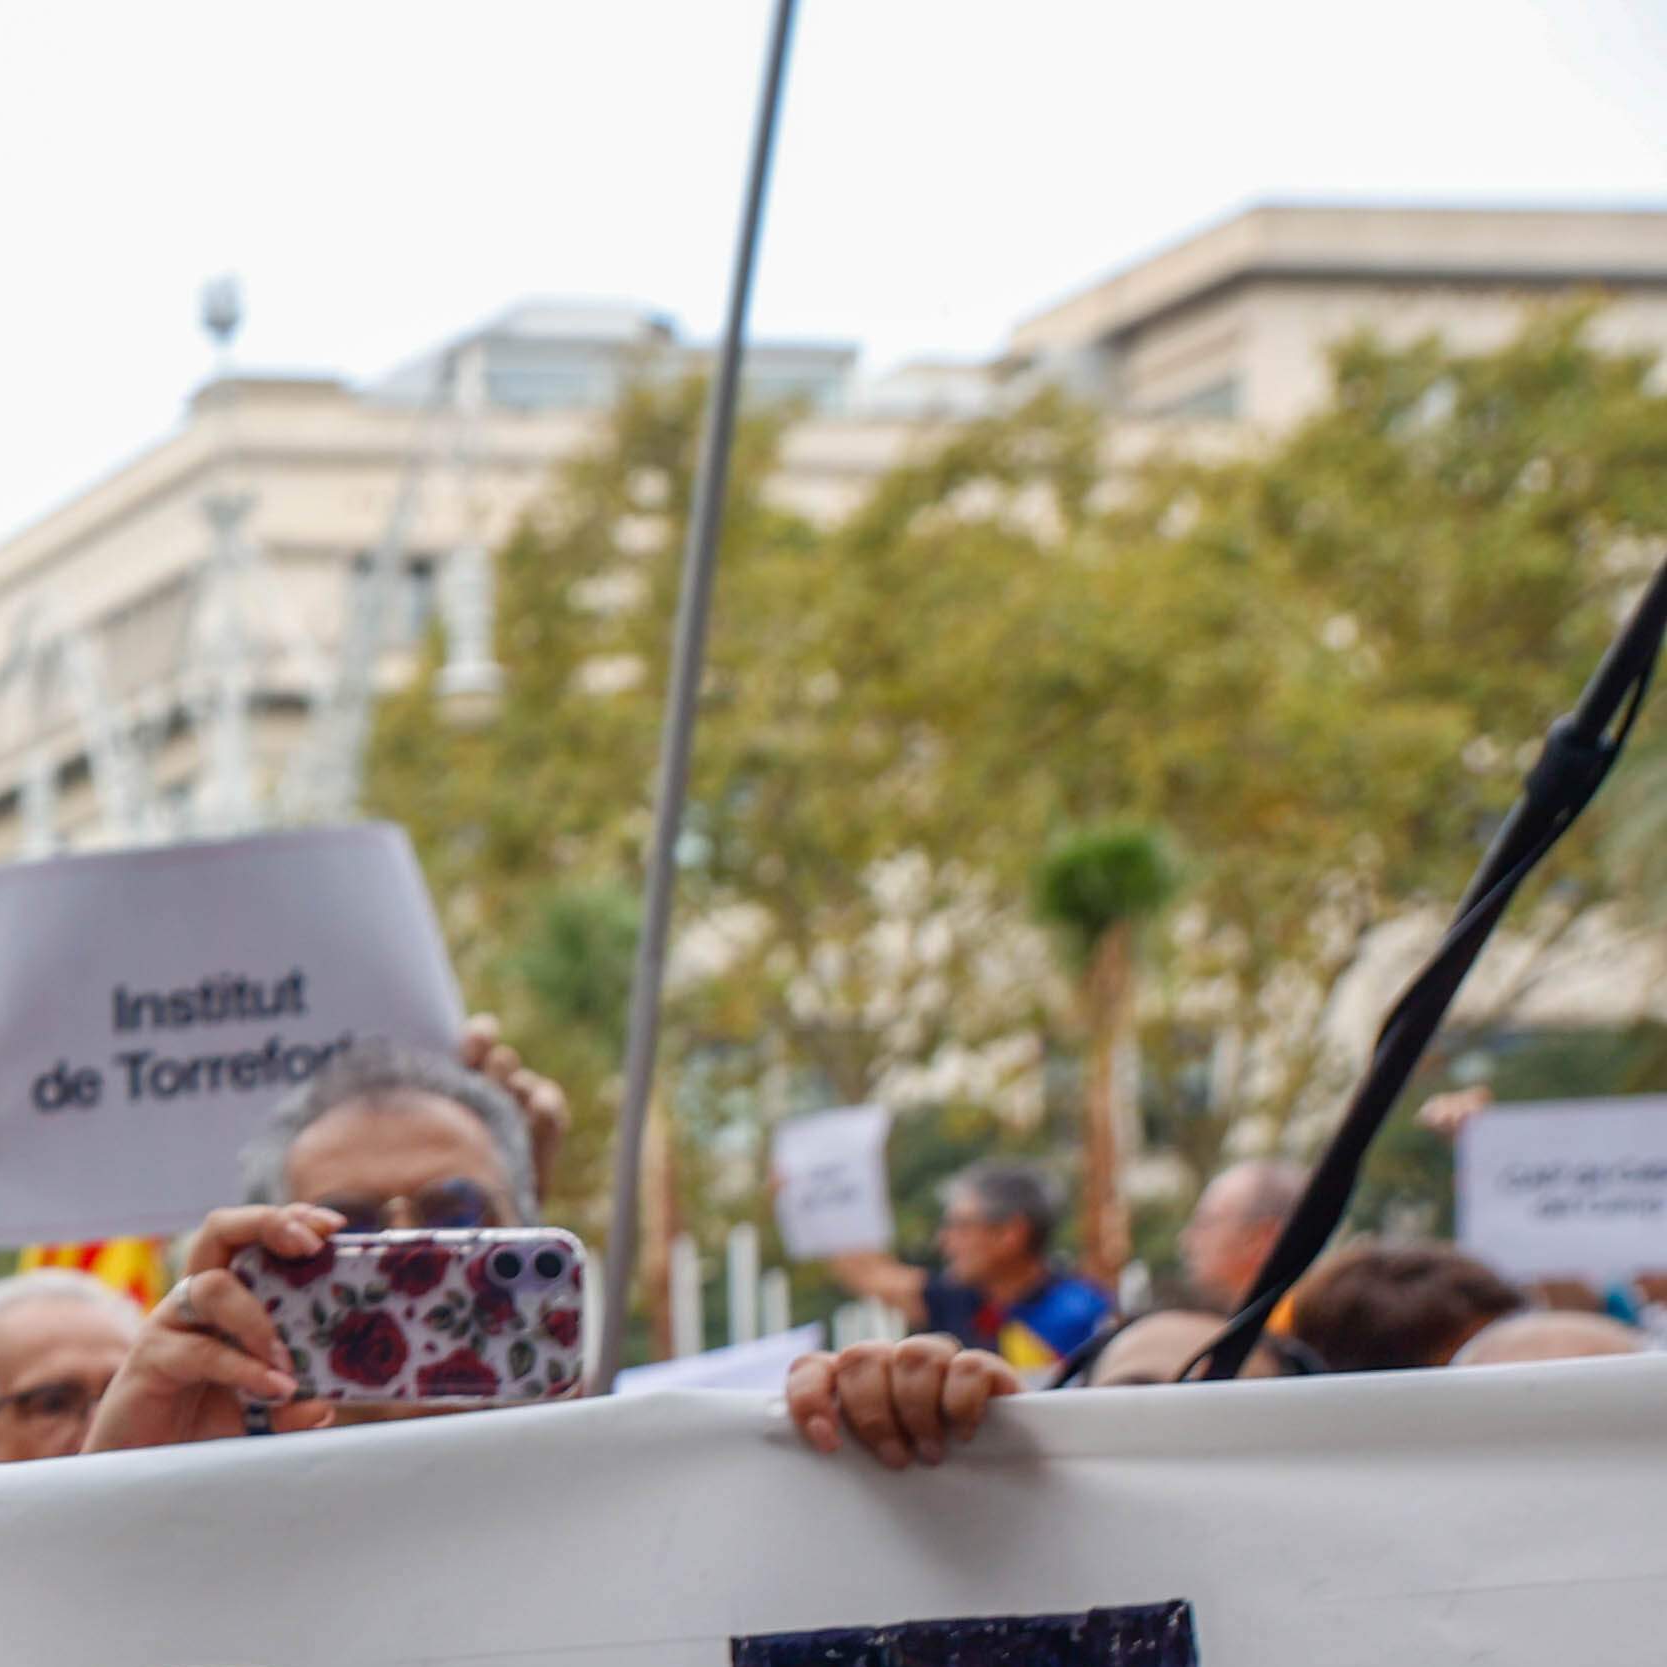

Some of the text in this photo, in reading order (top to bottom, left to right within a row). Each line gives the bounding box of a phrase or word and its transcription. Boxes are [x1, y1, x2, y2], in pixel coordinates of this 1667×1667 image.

[111, 963, 306, 1032] Institut
[30, 1030, 355, 1112] de Torrefor
